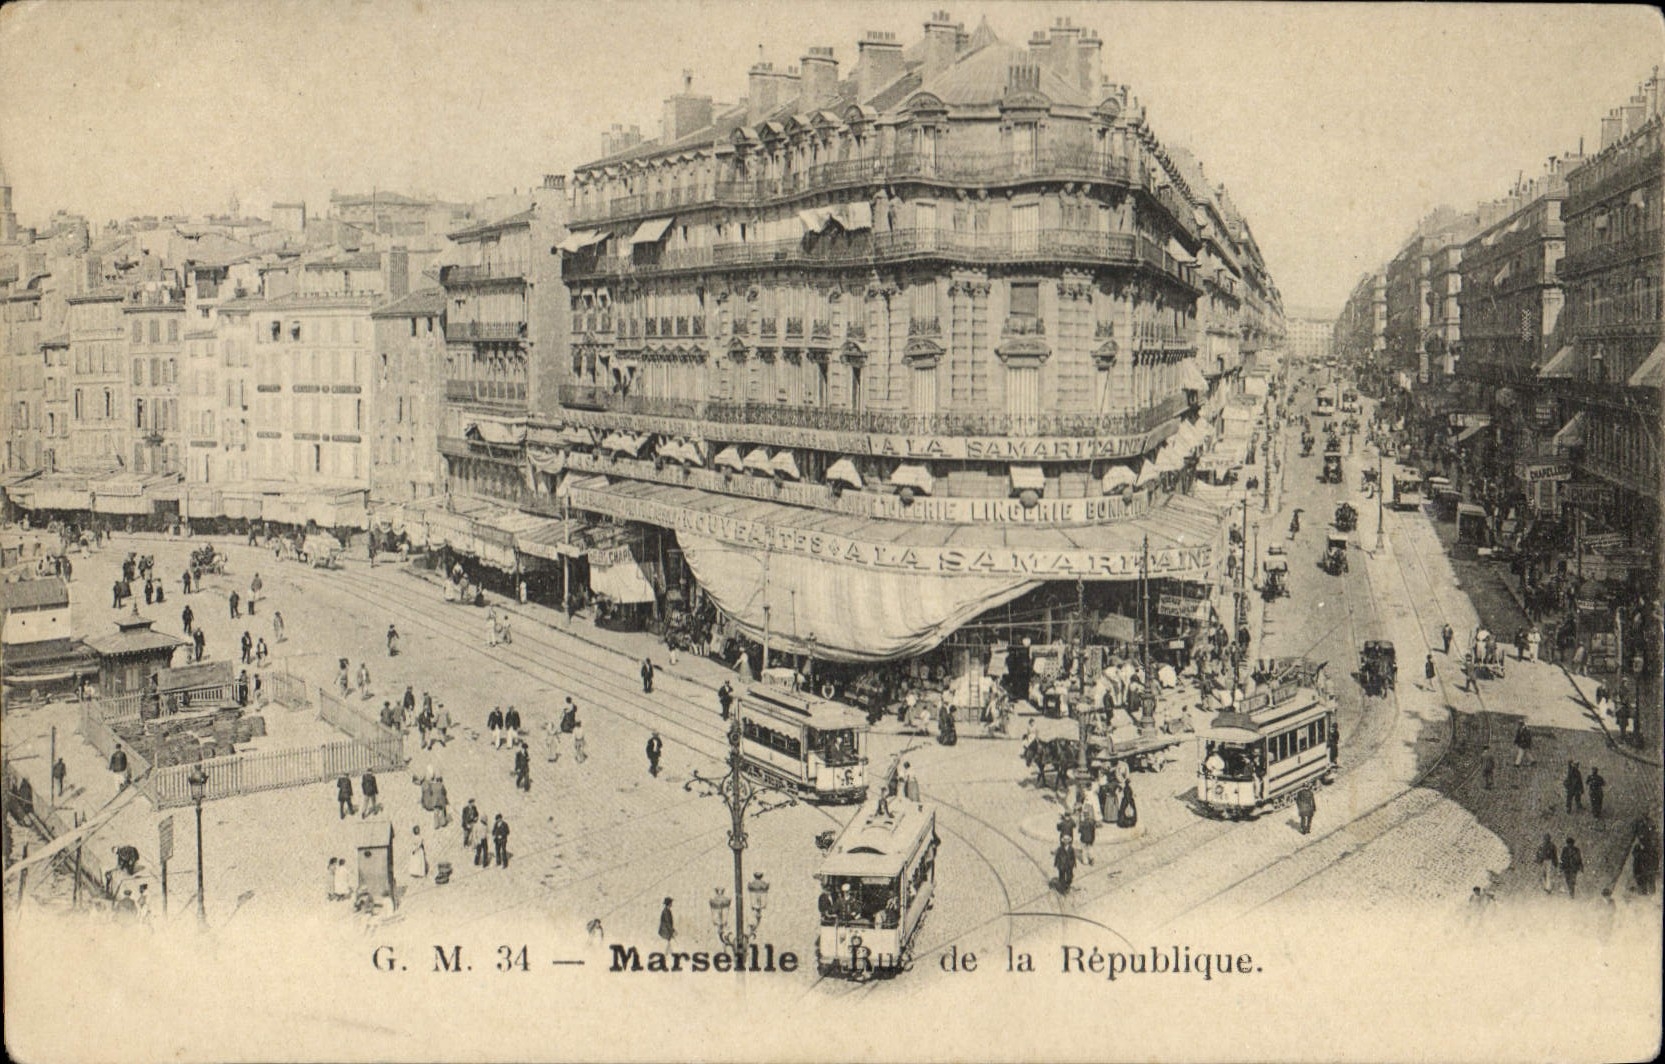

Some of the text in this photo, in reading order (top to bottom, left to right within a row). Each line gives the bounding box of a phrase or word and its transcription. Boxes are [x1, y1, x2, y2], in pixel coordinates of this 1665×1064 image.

[881, 436, 1143, 460] A LA SAMARITAINE
[971, 501, 1073, 521] LINGERIE
[873, 546, 931, 570] LA
[938, 546, 1213, 576] SAMARITAINE
